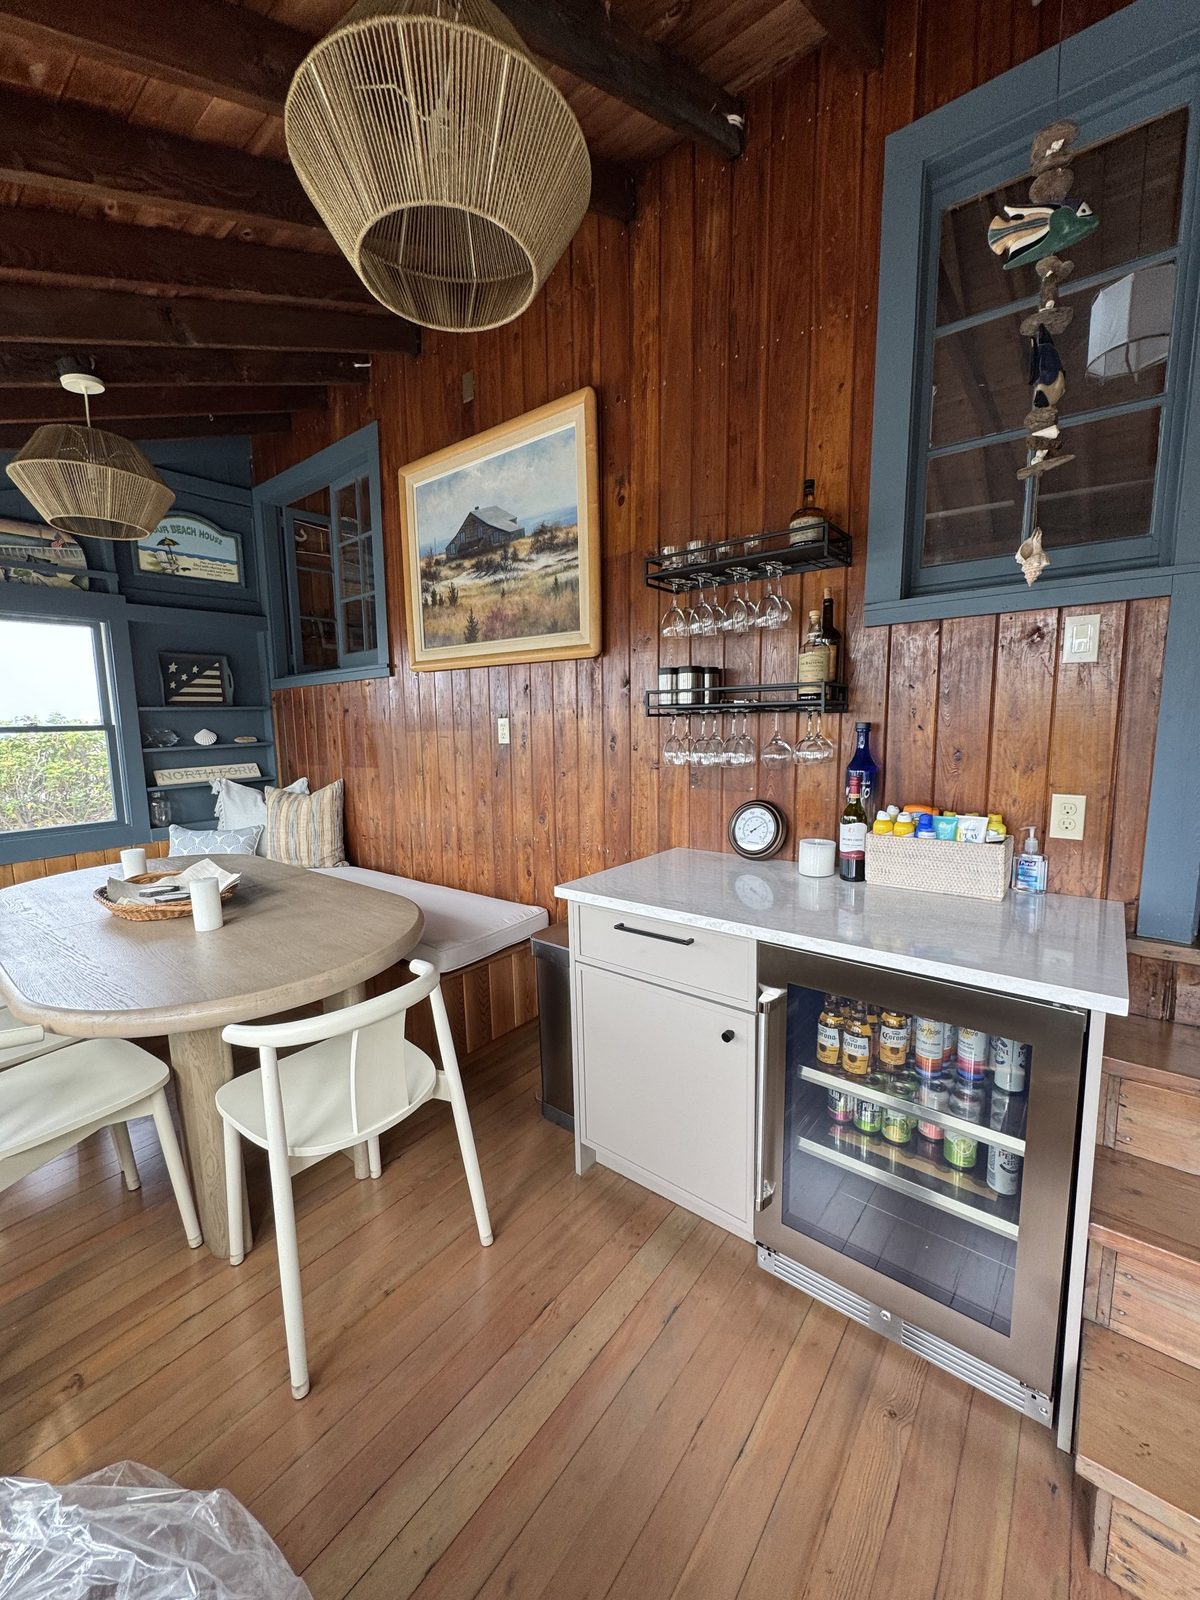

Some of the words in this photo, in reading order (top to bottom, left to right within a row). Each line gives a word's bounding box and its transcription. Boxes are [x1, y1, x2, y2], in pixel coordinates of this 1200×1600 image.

[170, 524, 197, 537] BEACH
[198, 529, 223, 546] HOUSE
[160, 768, 216, 781] NORTH
[219, 764, 257, 778] FORK
[818, 1031, 836, 1041] orona
[882, 1031, 908, 1042] Corona
[844, 1037, 867, 1050] Corona
